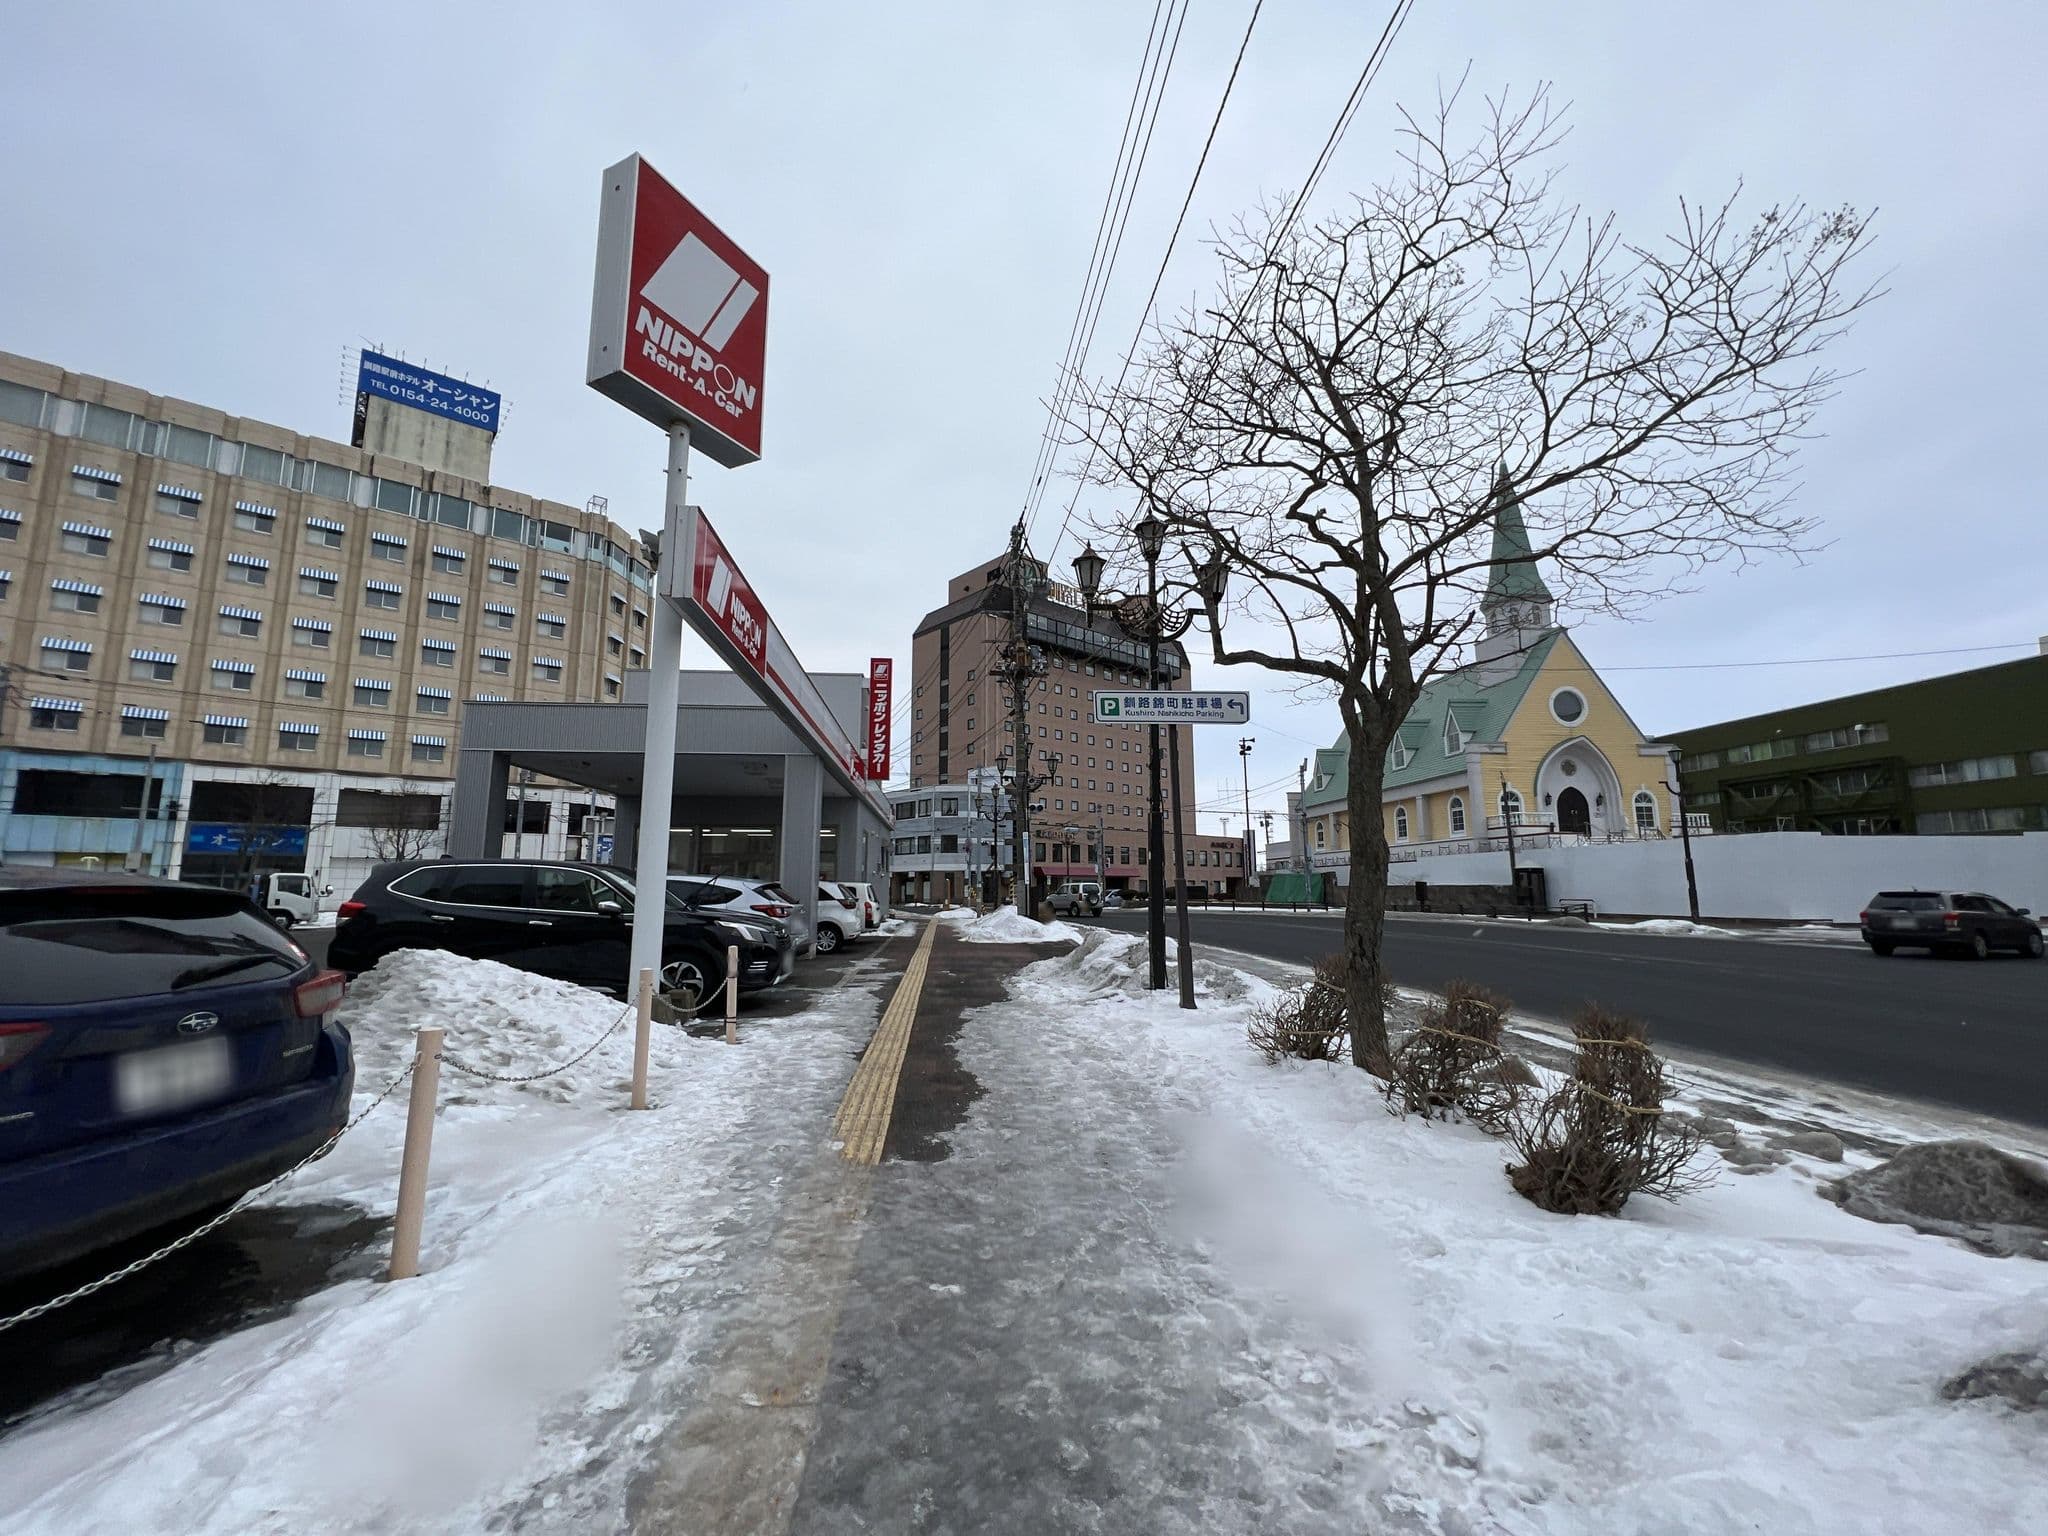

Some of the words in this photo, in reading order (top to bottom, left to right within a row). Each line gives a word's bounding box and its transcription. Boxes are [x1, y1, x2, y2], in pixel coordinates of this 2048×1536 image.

[635, 305, 756, 410] NIPPON
[642, 339, 743, 418] Rent-A-Car
[370, 379, 388, 391] TEL
[389, 385, 489, 423] 0154-24-4000
[421, 379, 496, 410] オーシャン
[731, 591, 761, 649] NIPPON
[873, 683, 887, 773] ニッポンレンタカー
[1195, 711, 1225, 719] Parking
